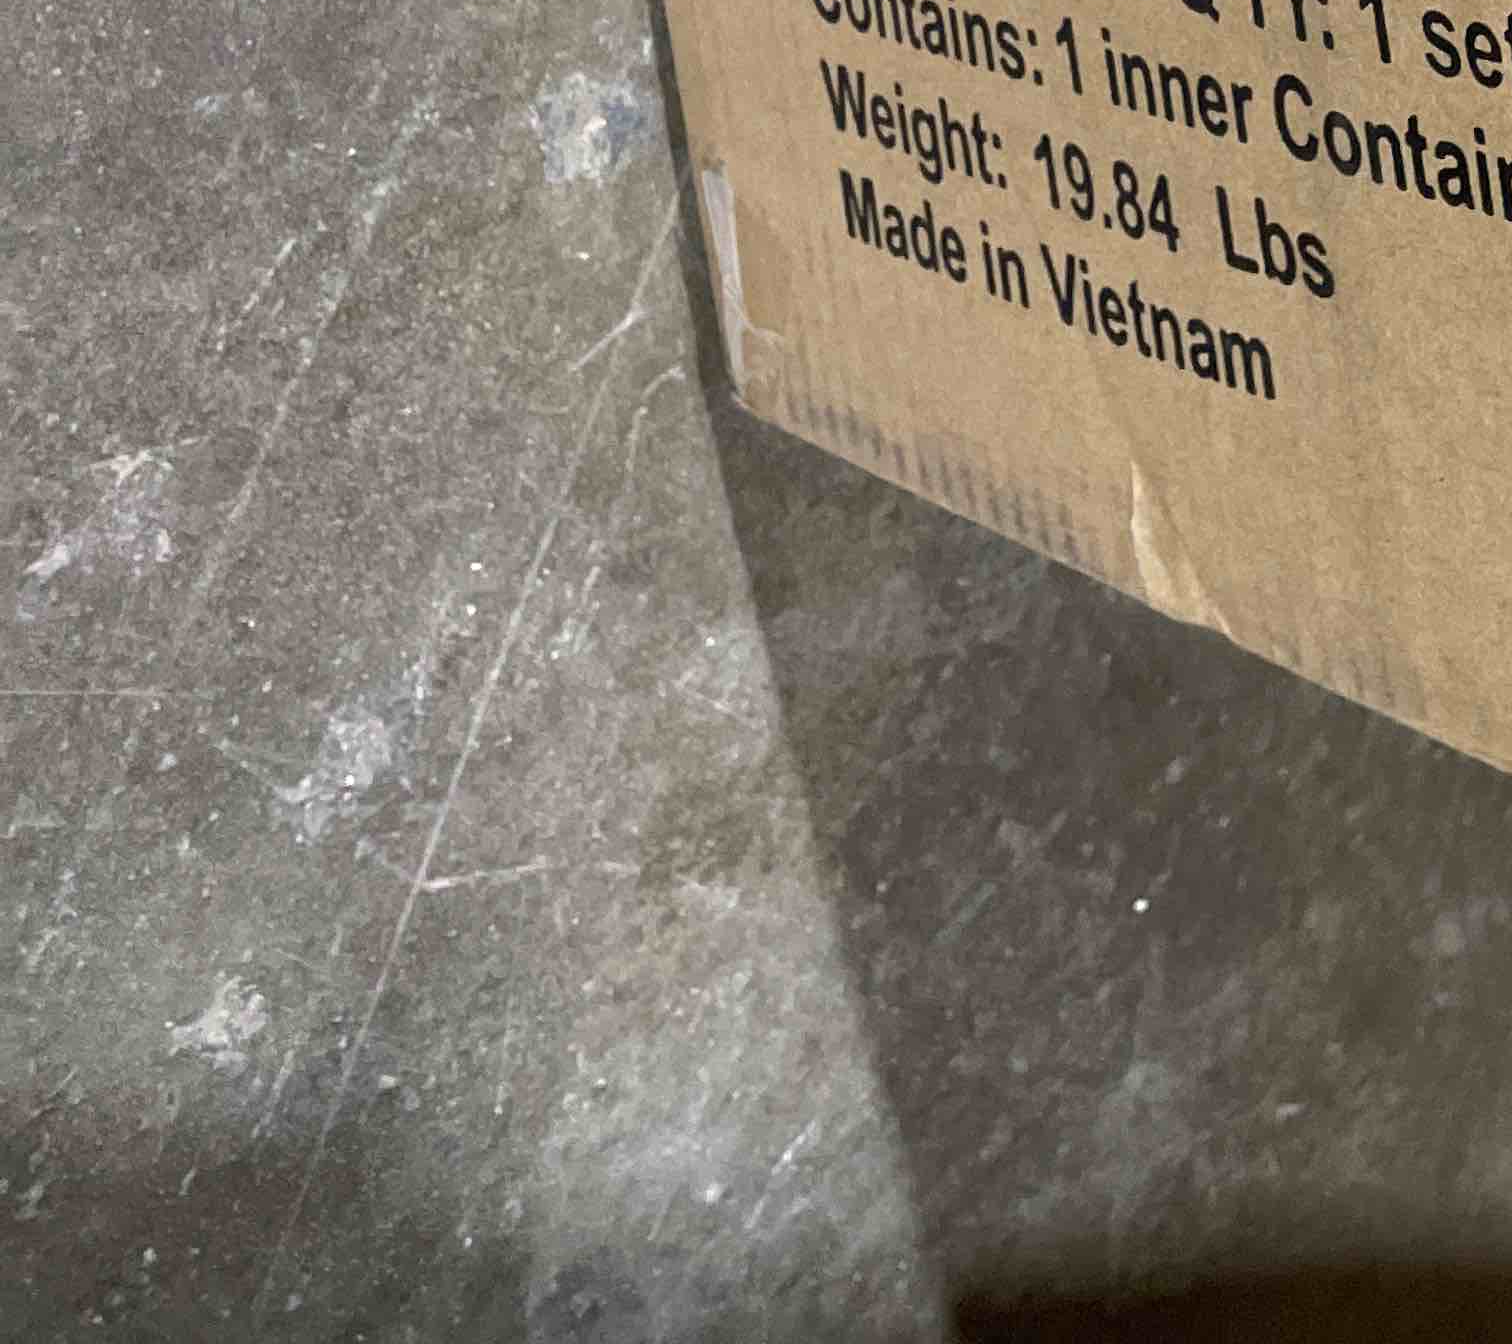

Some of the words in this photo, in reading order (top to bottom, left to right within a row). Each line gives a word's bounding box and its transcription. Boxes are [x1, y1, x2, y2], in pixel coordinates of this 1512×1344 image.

[821, 59, 1008, 190] Weight:
[1033, 133, 1180, 253] 19.84
[1215, 185, 1336, 299] Lbs
[1056, 15, 1084, 95] 1
[1101, 26, 1255, 146] inner
[839, 170, 967, 284] Made
[981, 220, 1030, 309] in
[1040, 243, 1277, 402] Vietnam
